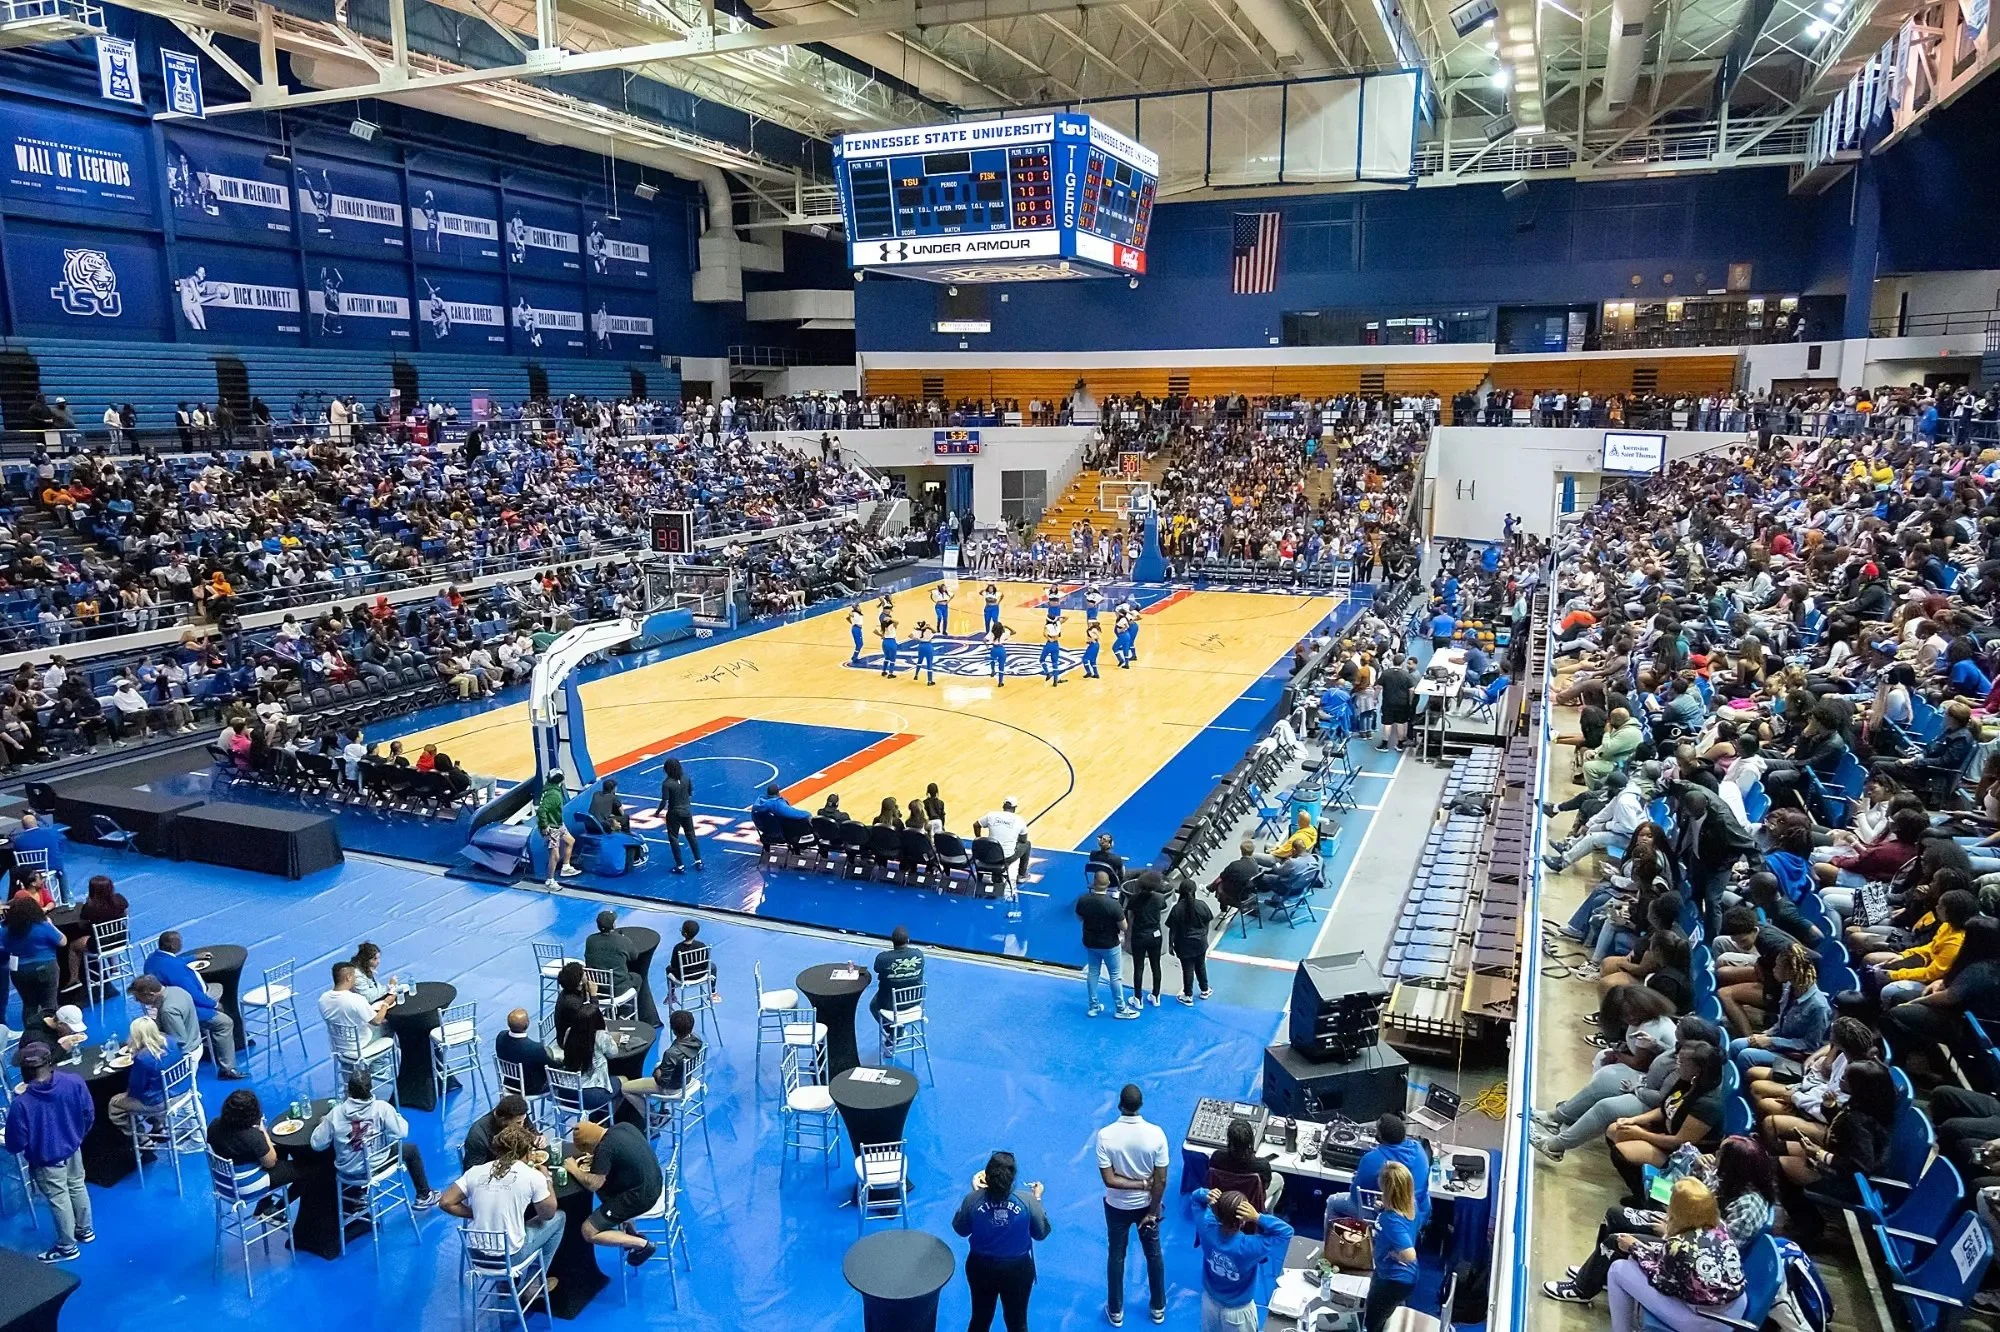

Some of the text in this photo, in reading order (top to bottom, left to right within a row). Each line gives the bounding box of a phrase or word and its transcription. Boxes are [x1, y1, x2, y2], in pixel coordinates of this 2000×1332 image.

[103, 46, 131, 57] JARRETT
[112, 76, 130, 91] 24
[177, 91, 192, 104] 35
[1058, 120, 1086, 136] tsu
[846, 122, 1052, 151] TENNESSEE STATE UNIVERSITY
[1091, 125, 1118, 149] TENNESSEE
[18, 136, 122, 158] TENNESSEE STATE UNIVERSITY
[14, 144, 131, 187] WALL OF LEGENDS
[1043, 157, 1048, 166] 5
[902, 178, 918, 187] TSU
[980, 172, 995, 180] FISK
[1028, 173, 1033, 182] 0
[1043, 171, 1049, 181] 0
[219, 179, 239, 198] JOHN
[1020, 187, 1025, 196] 7
[1029, 187, 1034, 196] 0
[1064, 145, 1077, 228] TIGERS
[336, 199, 395, 222] LEONARD ROBINSON
[1017, 200, 1050, 212] 10 0 0
[444, 216, 490, 235] ROBERT COVINGTON
[1018, 216, 1027, 226] 12
[1030, 216, 1036, 225] 0
[912, 239, 1031, 255] UNDER ARMOUR
[233, 287, 291, 308] DICK BARNETT
[346, 298, 398, 314] ANTHONY MASON
[451, 306, 492, 322] CARLOS ROGERS
[539, 312, 576, 327] SHARON JARRETT
[1123, 461, 1134, 471] 30
